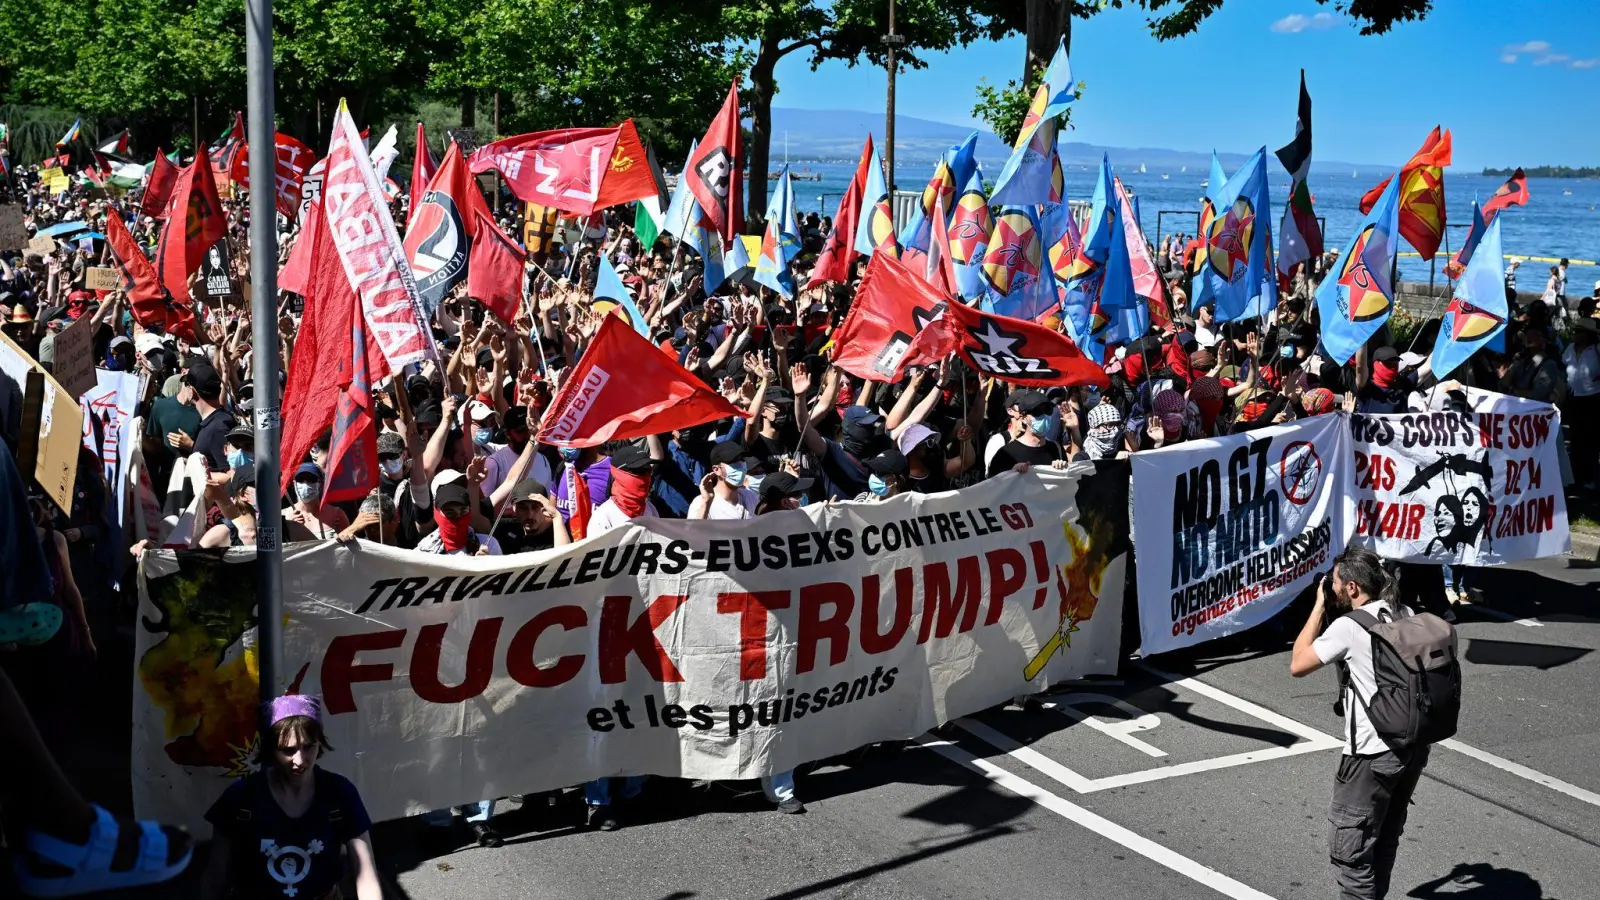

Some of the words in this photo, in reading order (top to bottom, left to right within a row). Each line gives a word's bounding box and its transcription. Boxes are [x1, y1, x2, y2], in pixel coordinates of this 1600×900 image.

[970, 350, 1053, 374] RJZ
[553, 372, 602, 440] AUFBAU
[1400, 412, 1475, 449] CORPS
[1479, 413, 1505, 450] NE
[1173, 458, 1222, 533] NO
[1228, 436, 1274, 515] G7
[1354, 454, 1397, 492] PAS
[861, 512, 971, 556] CONTRE
[966, 507, 1003, 537] LE
[1000, 502, 1034, 531] G7
[1170, 522, 1209, 590] NO
[1215, 488, 1280, 569] NATO
[1356, 499, 1426, 541] CHAIR
[1496, 494, 1555, 539] CANON
[1171, 561, 1245, 622] OVERCOME
[1172, 594, 1236, 637] organize
[1237, 585, 1260, 606] the
[320, 595, 690, 716] FUCK
[716, 540, 1050, 682] TRUMP!
[587, 700, 635, 733] et
[645, 694, 715, 731] les
[728, 665, 899, 737] puissants
